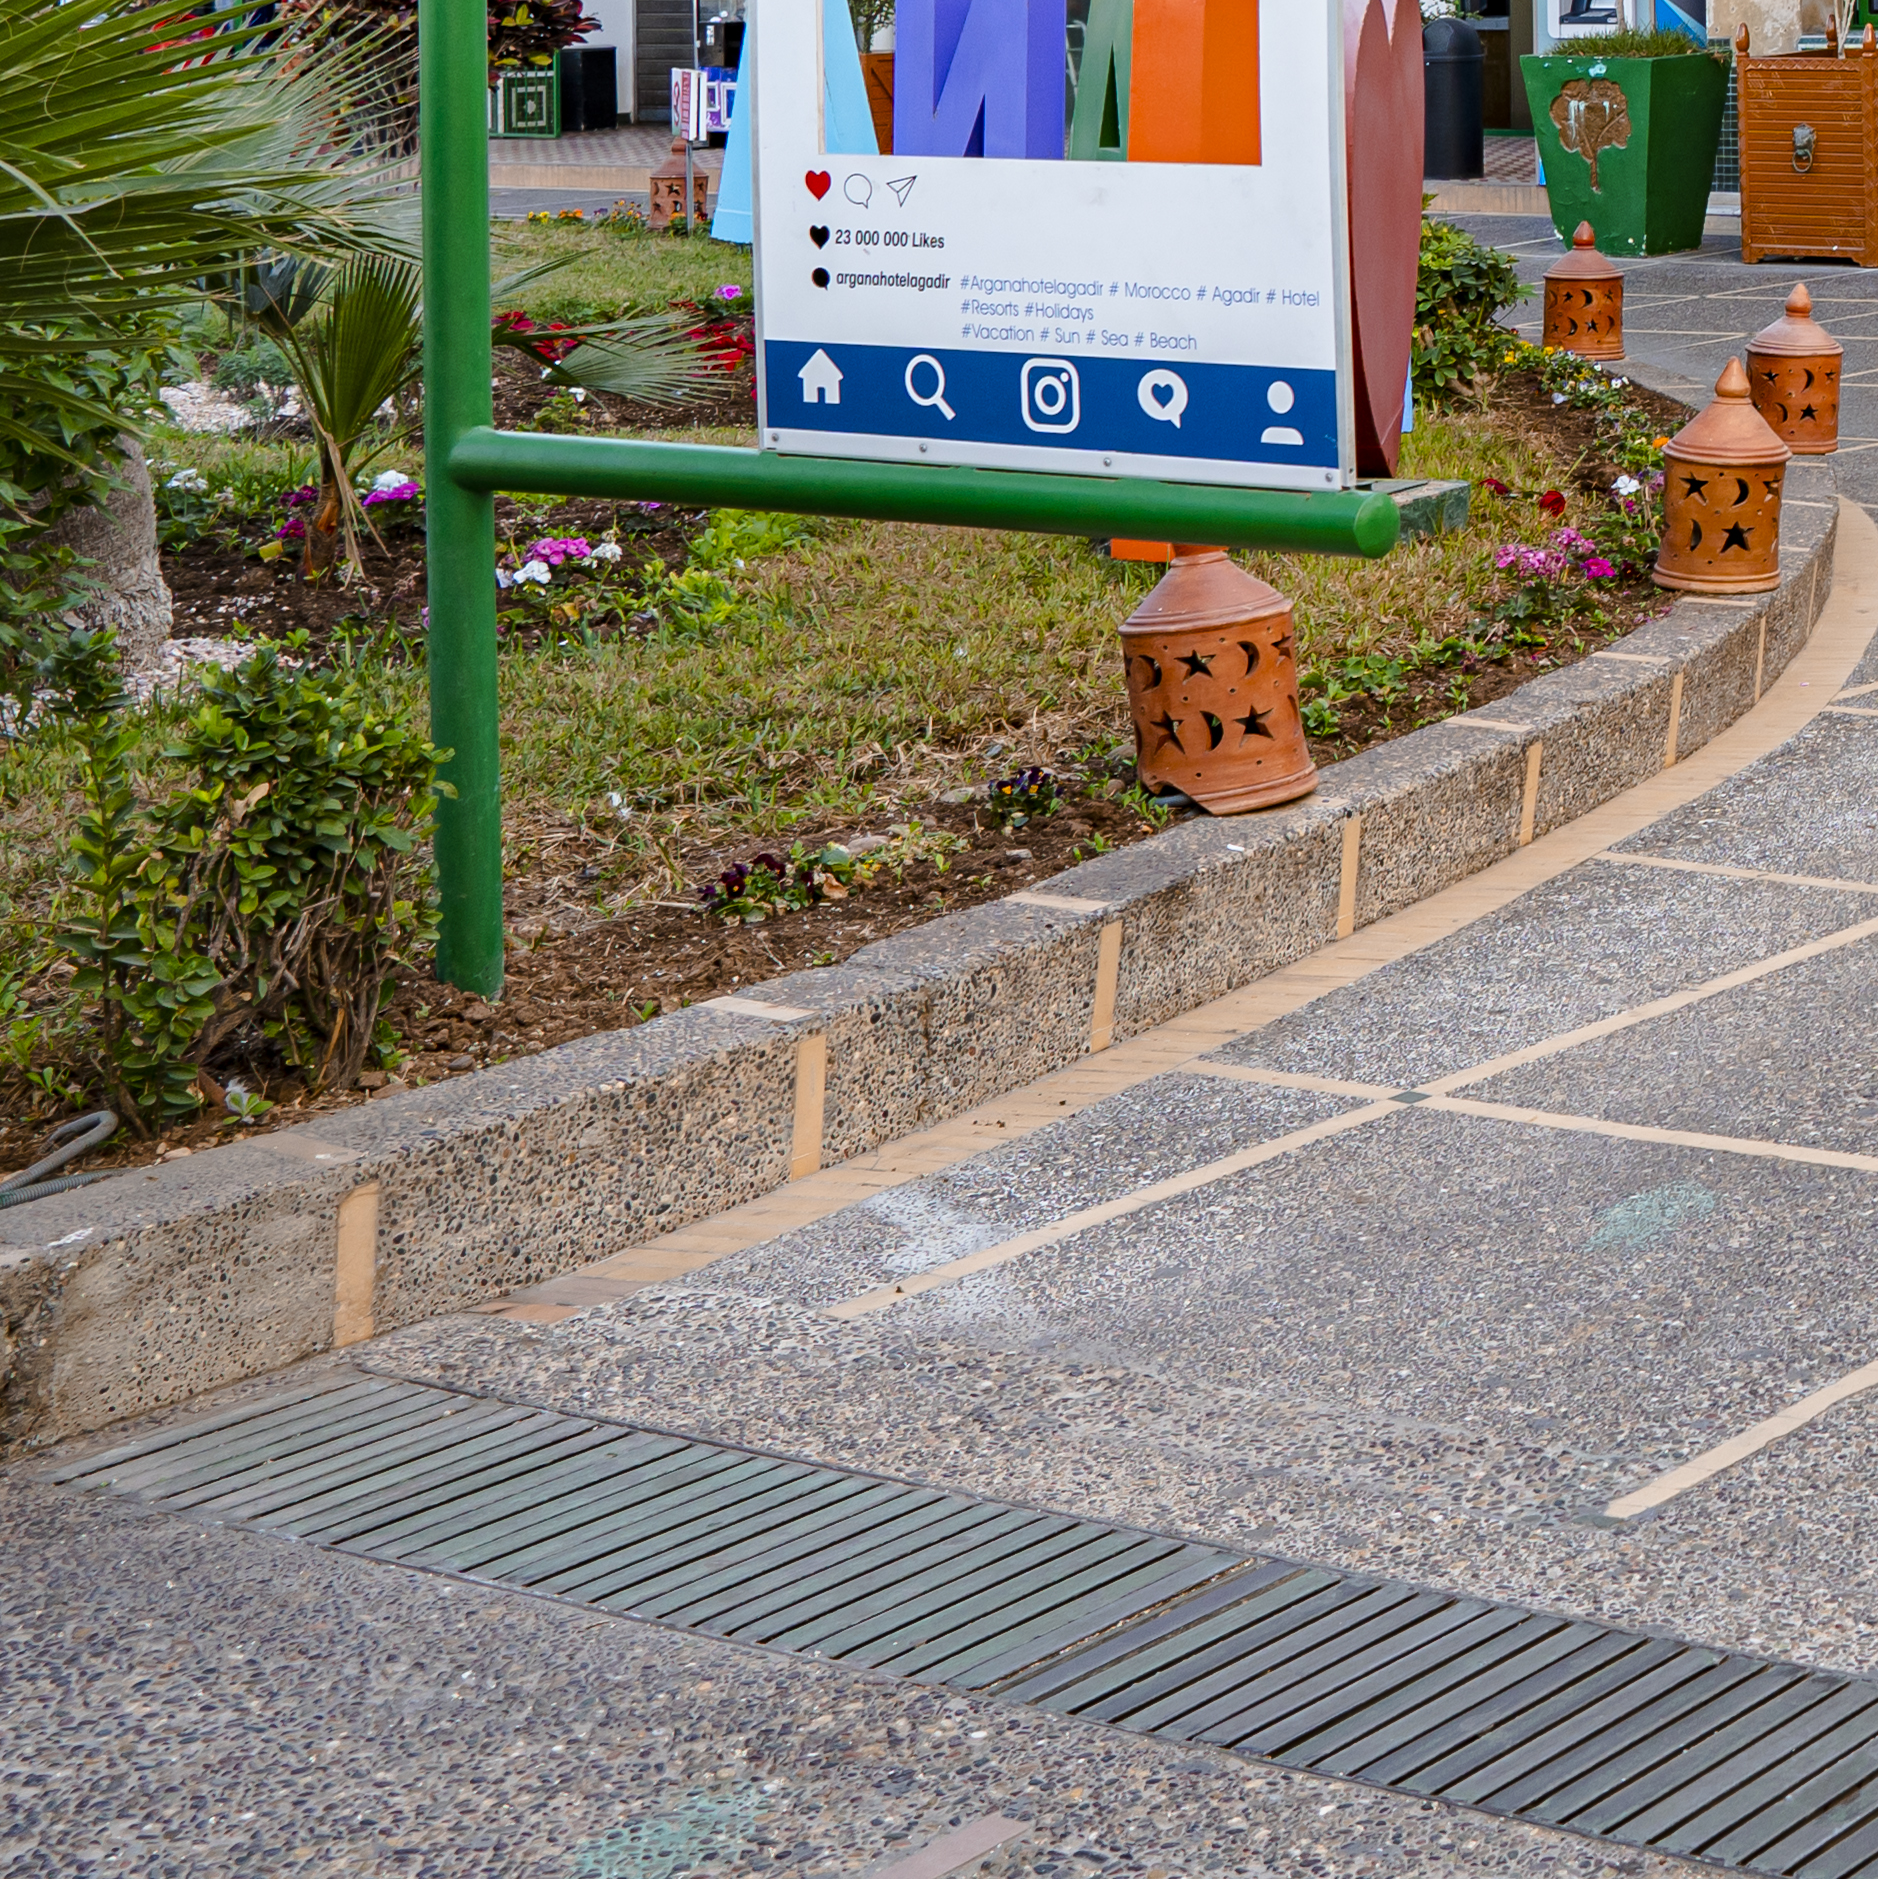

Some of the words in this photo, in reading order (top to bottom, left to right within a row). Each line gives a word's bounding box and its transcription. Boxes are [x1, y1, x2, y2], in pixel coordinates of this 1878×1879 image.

[835, 229, 851, 245] 23
[855, 230, 880, 247] 000
[884, 231, 909, 248] 000
[912, 232, 945, 249] Likes
[836, 270, 951, 292] arganahotelagadir
[960, 274, 1103, 299] #Arganahotelagadir
[1124, 282, 1191, 301] Morocco
[1212, 286, 1260, 306] Agadir
[1282, 290, 1320, 307] Hotel
[960, 299, 1019, 318] #Resorts
[1024, 301, 1094, 323] #Holidays
[961, 323, 1034, 342] #Vacation
[1055, 327, 1080, 344] Sun
[1101, 330, 1129, 347] Sea
[1150, 332, 1197, 351] Beach
